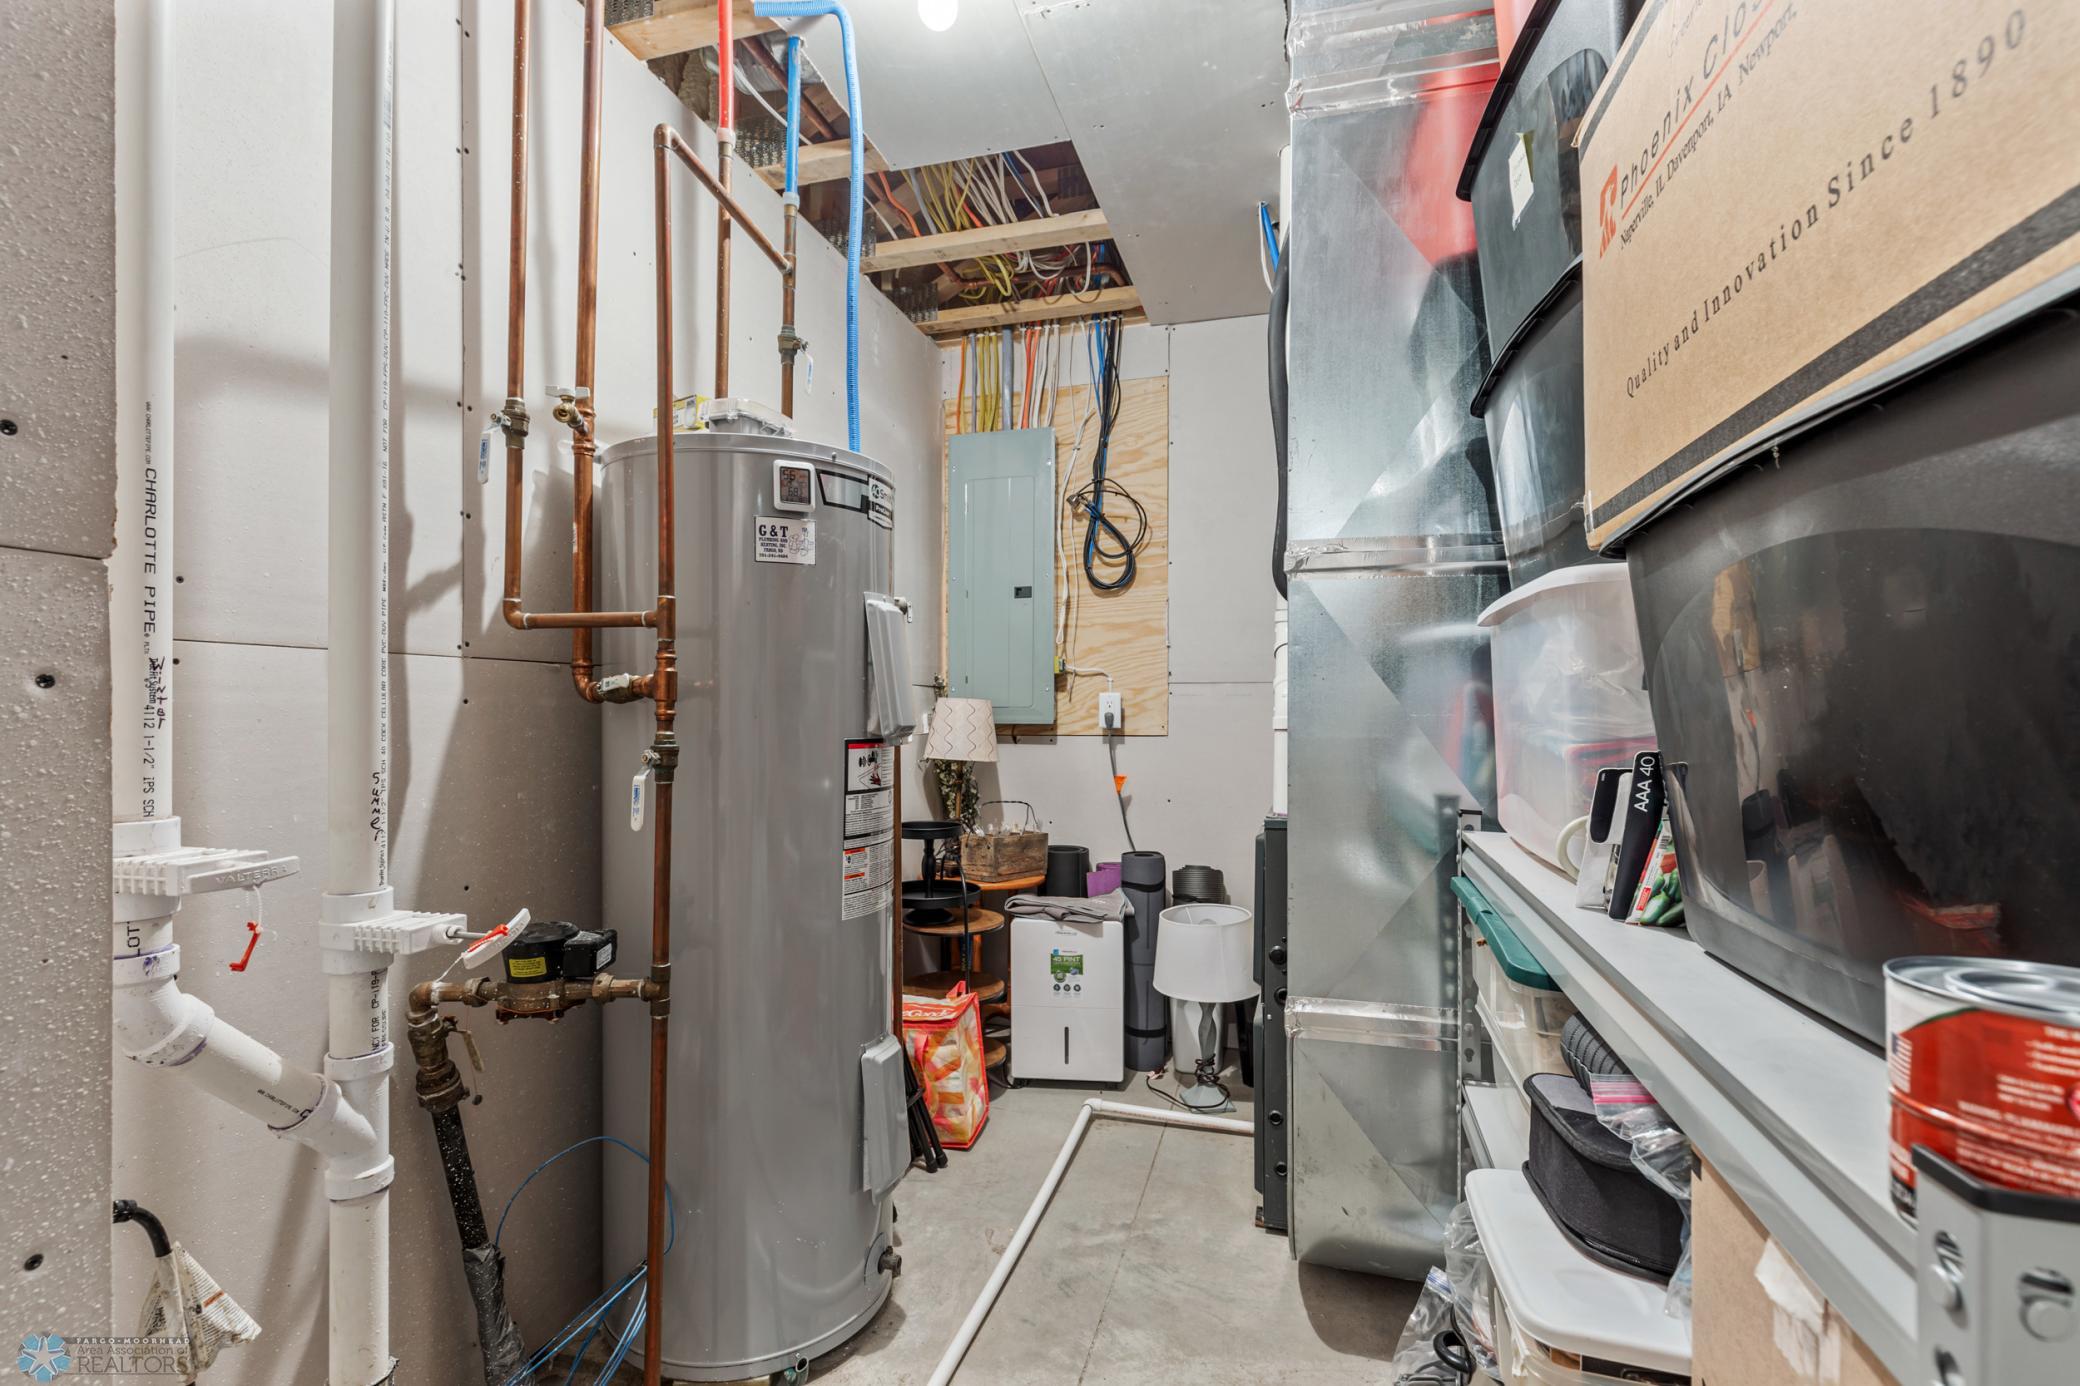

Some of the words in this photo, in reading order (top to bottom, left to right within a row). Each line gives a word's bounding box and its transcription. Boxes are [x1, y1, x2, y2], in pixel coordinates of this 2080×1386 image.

[1621, 76, 1694, 209] Phoenix
[1626, 342, 1669, 398] Quality
[1674, 310, 1699, 351] and
[1703, 204, 1819, 322] Innovation
[1828, 117, 1914, 209] Since
[1929, 8, 2026, 119] 1890
[144, 468, 157, 574] CHARLOTTE
[758, 524, 767, 537] G
[769, 525, 778, 537] &
[779, 526, 789, 537] T
[1638, 755, 1656, 777] 40
[143, 799, 155, 818] SCH
[1633, 780, 1653, 813] AAA
